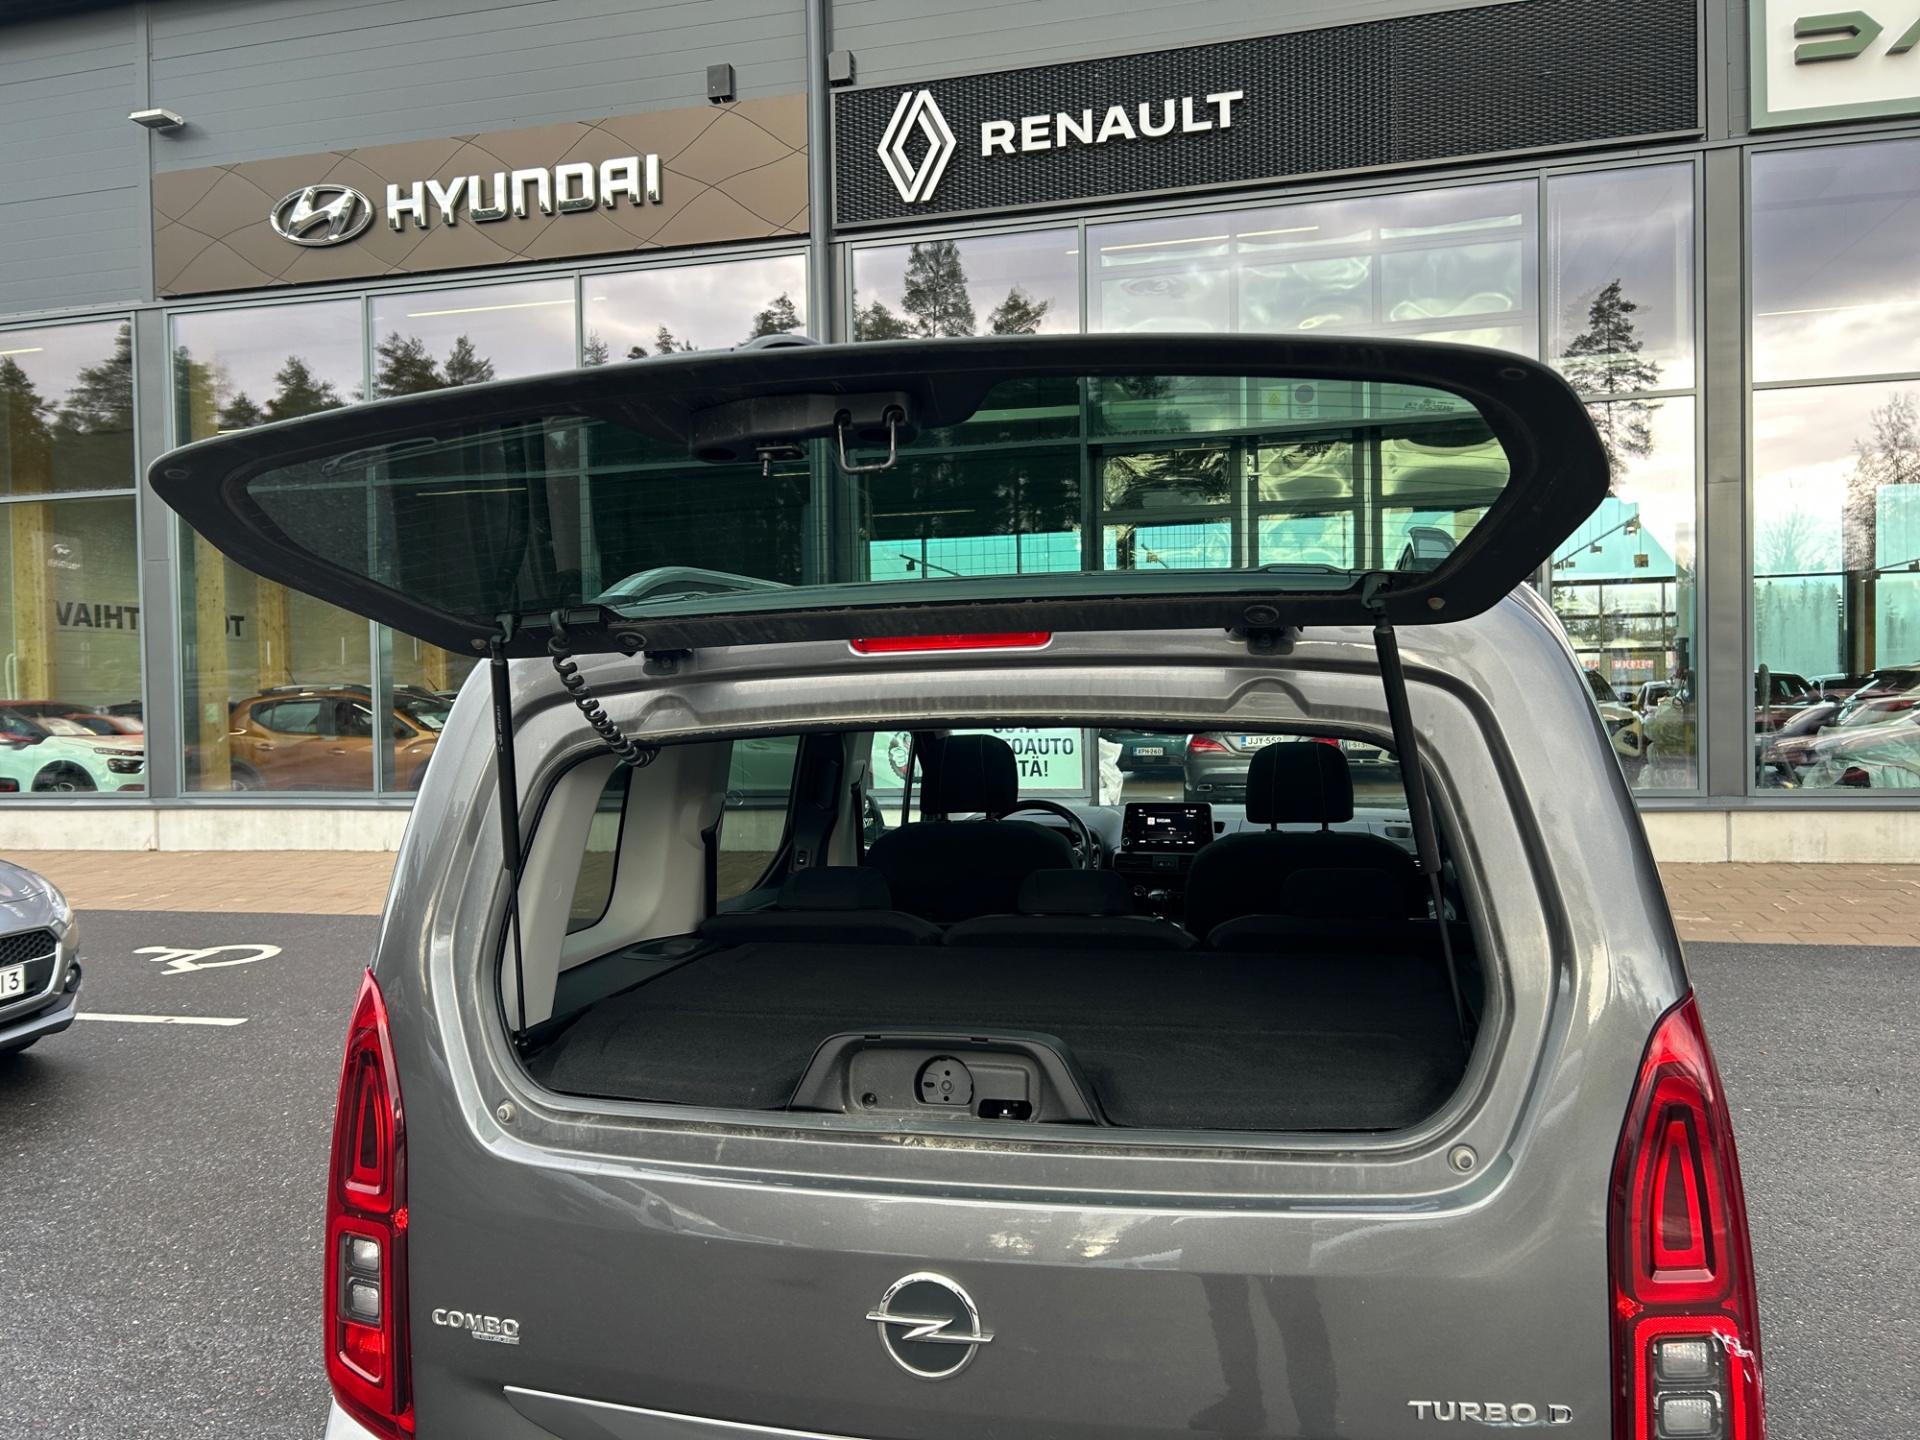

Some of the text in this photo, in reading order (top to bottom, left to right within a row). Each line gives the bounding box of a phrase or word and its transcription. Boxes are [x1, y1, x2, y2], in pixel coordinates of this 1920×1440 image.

[981, 89, 1244, 157] RENAULT
[386, 153, 661, 231] HYUNDAI
[1247, 736, 1283, 745] JJY-552
[1018, 756, 1049, 777] TÄ!
[431, 1308, 519, 1336] COMBO
[1407, 1400, 1574, 1424] TURBO D
